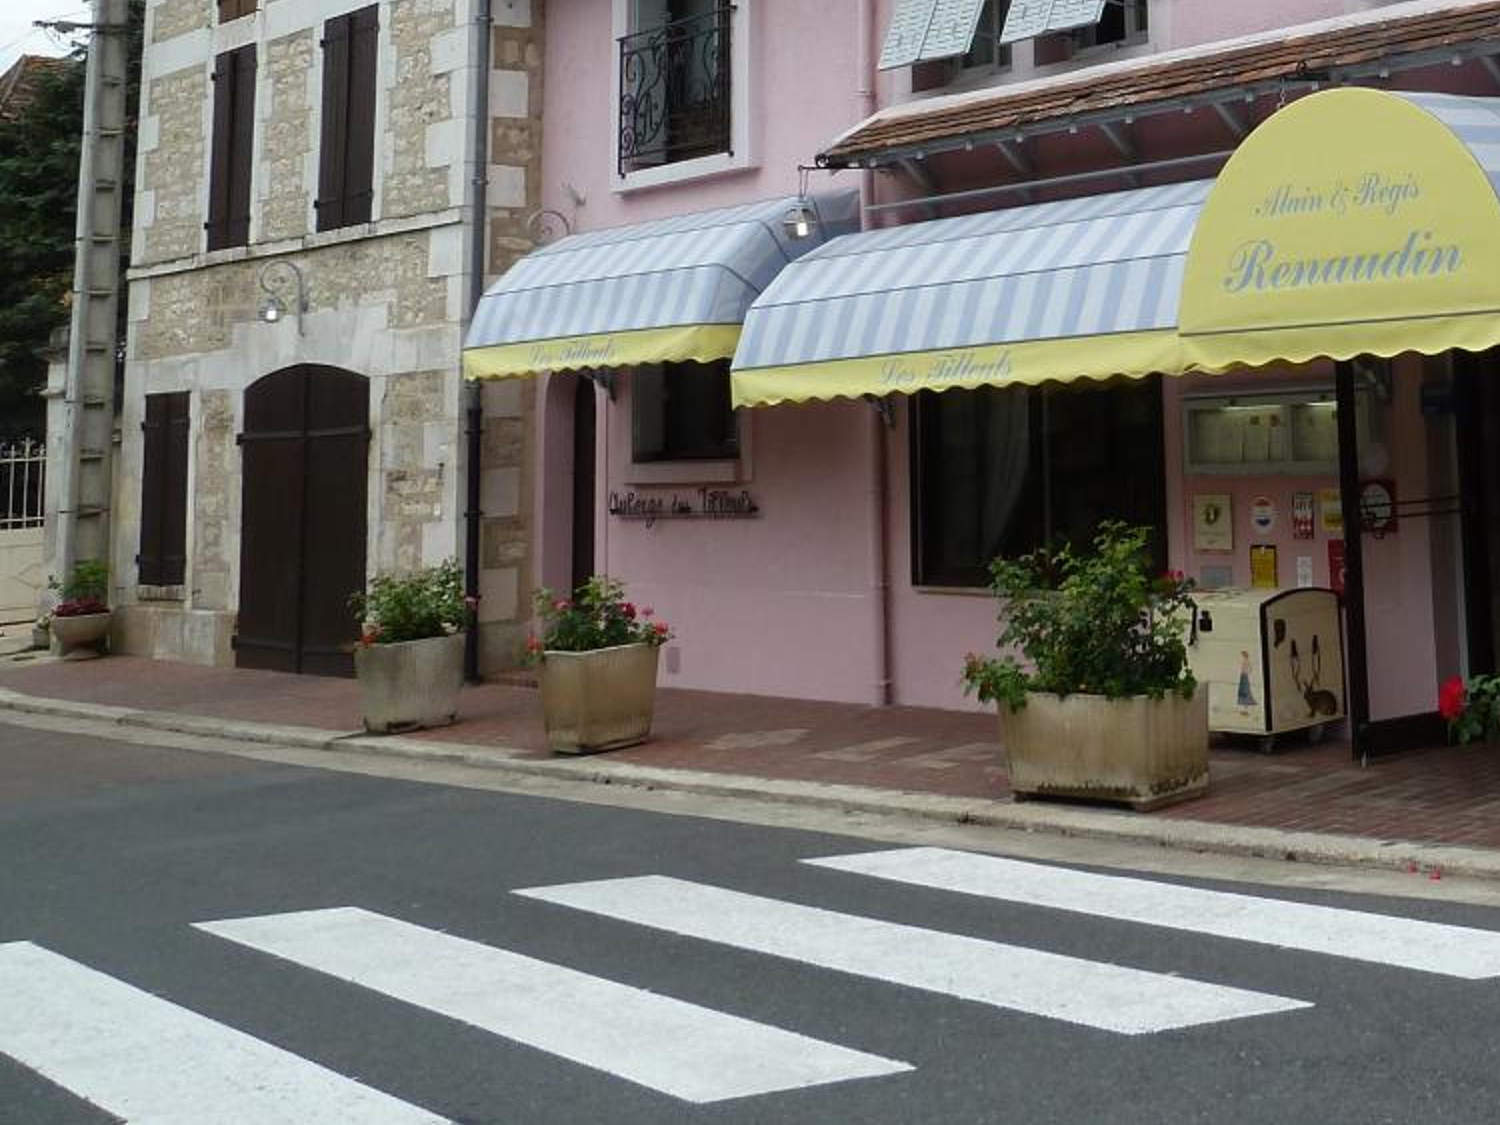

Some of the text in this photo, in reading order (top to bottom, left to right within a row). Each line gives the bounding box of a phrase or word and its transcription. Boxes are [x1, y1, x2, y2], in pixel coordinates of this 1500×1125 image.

[1254, 186, 1323, 217] Alain
[1351, 172, 1420, 215] Régis
[1223, 231, 1463, 294] Renaudin
